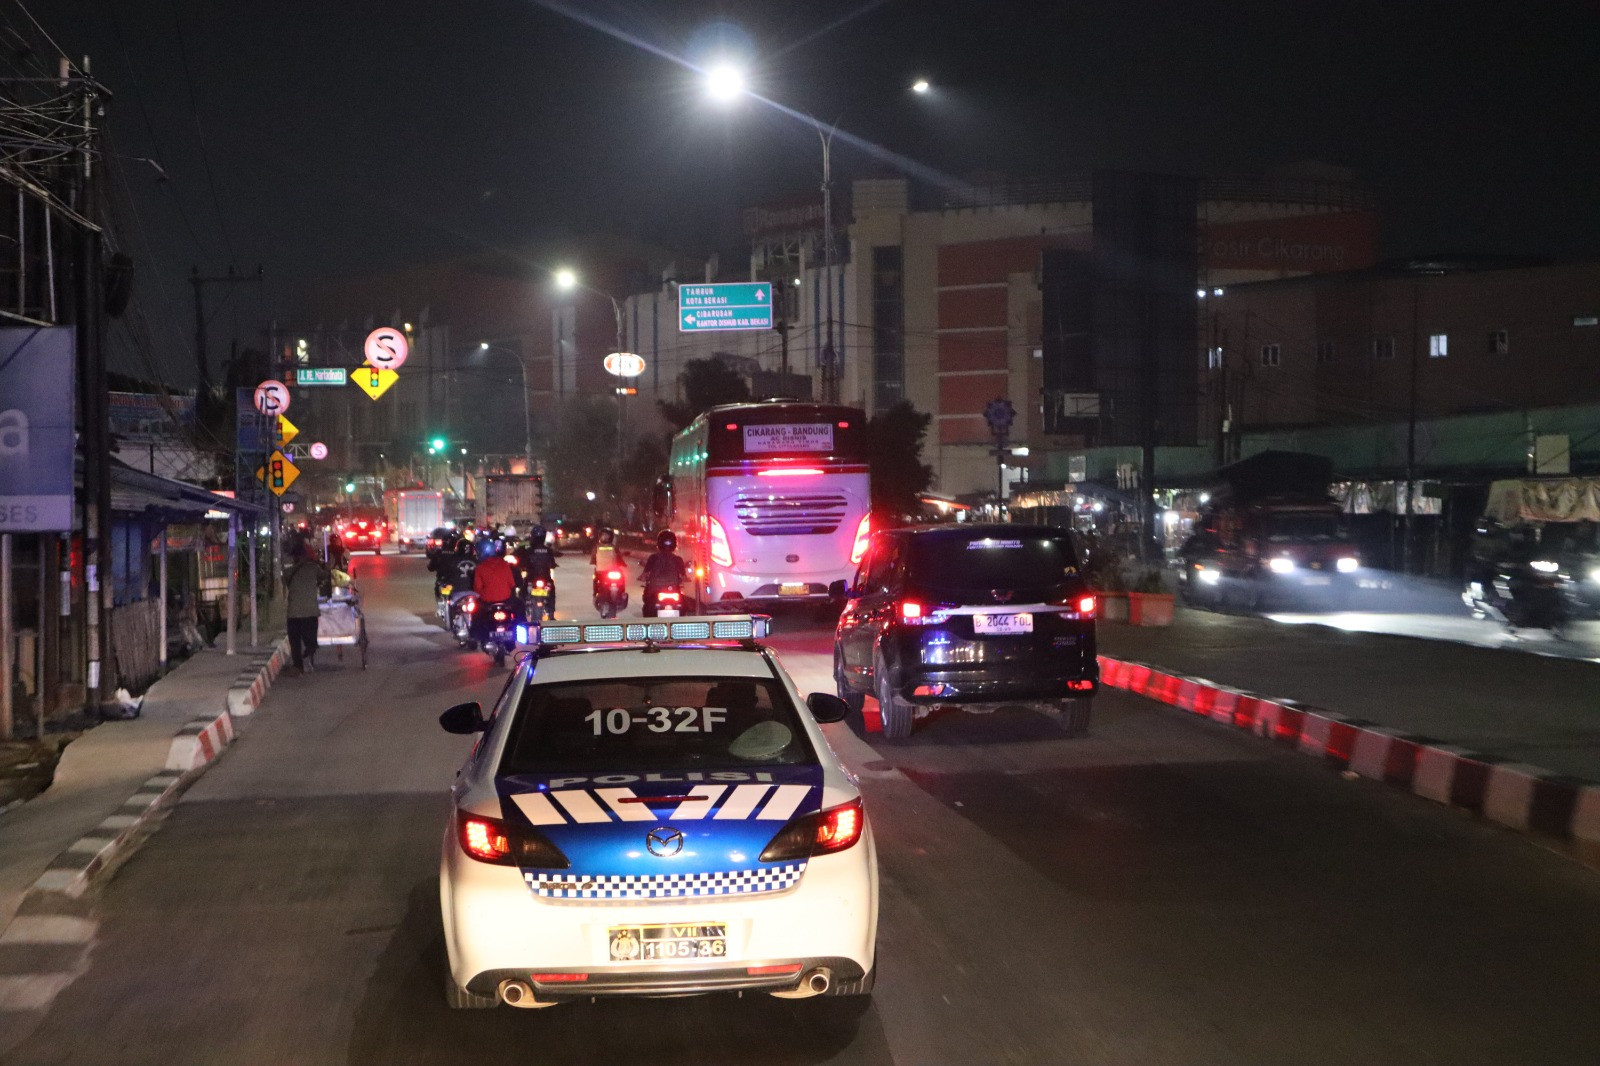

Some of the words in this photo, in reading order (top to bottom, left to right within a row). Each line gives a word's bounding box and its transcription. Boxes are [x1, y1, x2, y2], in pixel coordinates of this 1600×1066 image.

[1258, 237, 1344, 266] Cikarang
[696, 310, 733, 318] CIBARUSAH
[696, 320, 718, 328] KANTOR
[747, 427, 786, 437] CIKARANG
[792, 426, 829, 435] BANDUNG
[986, 616, 1009, 627] 2044
[585, 706, 727, 735] 10-32F
[549, 772, 773, 788] POLISI
[673, 927, 697, 938] VII
